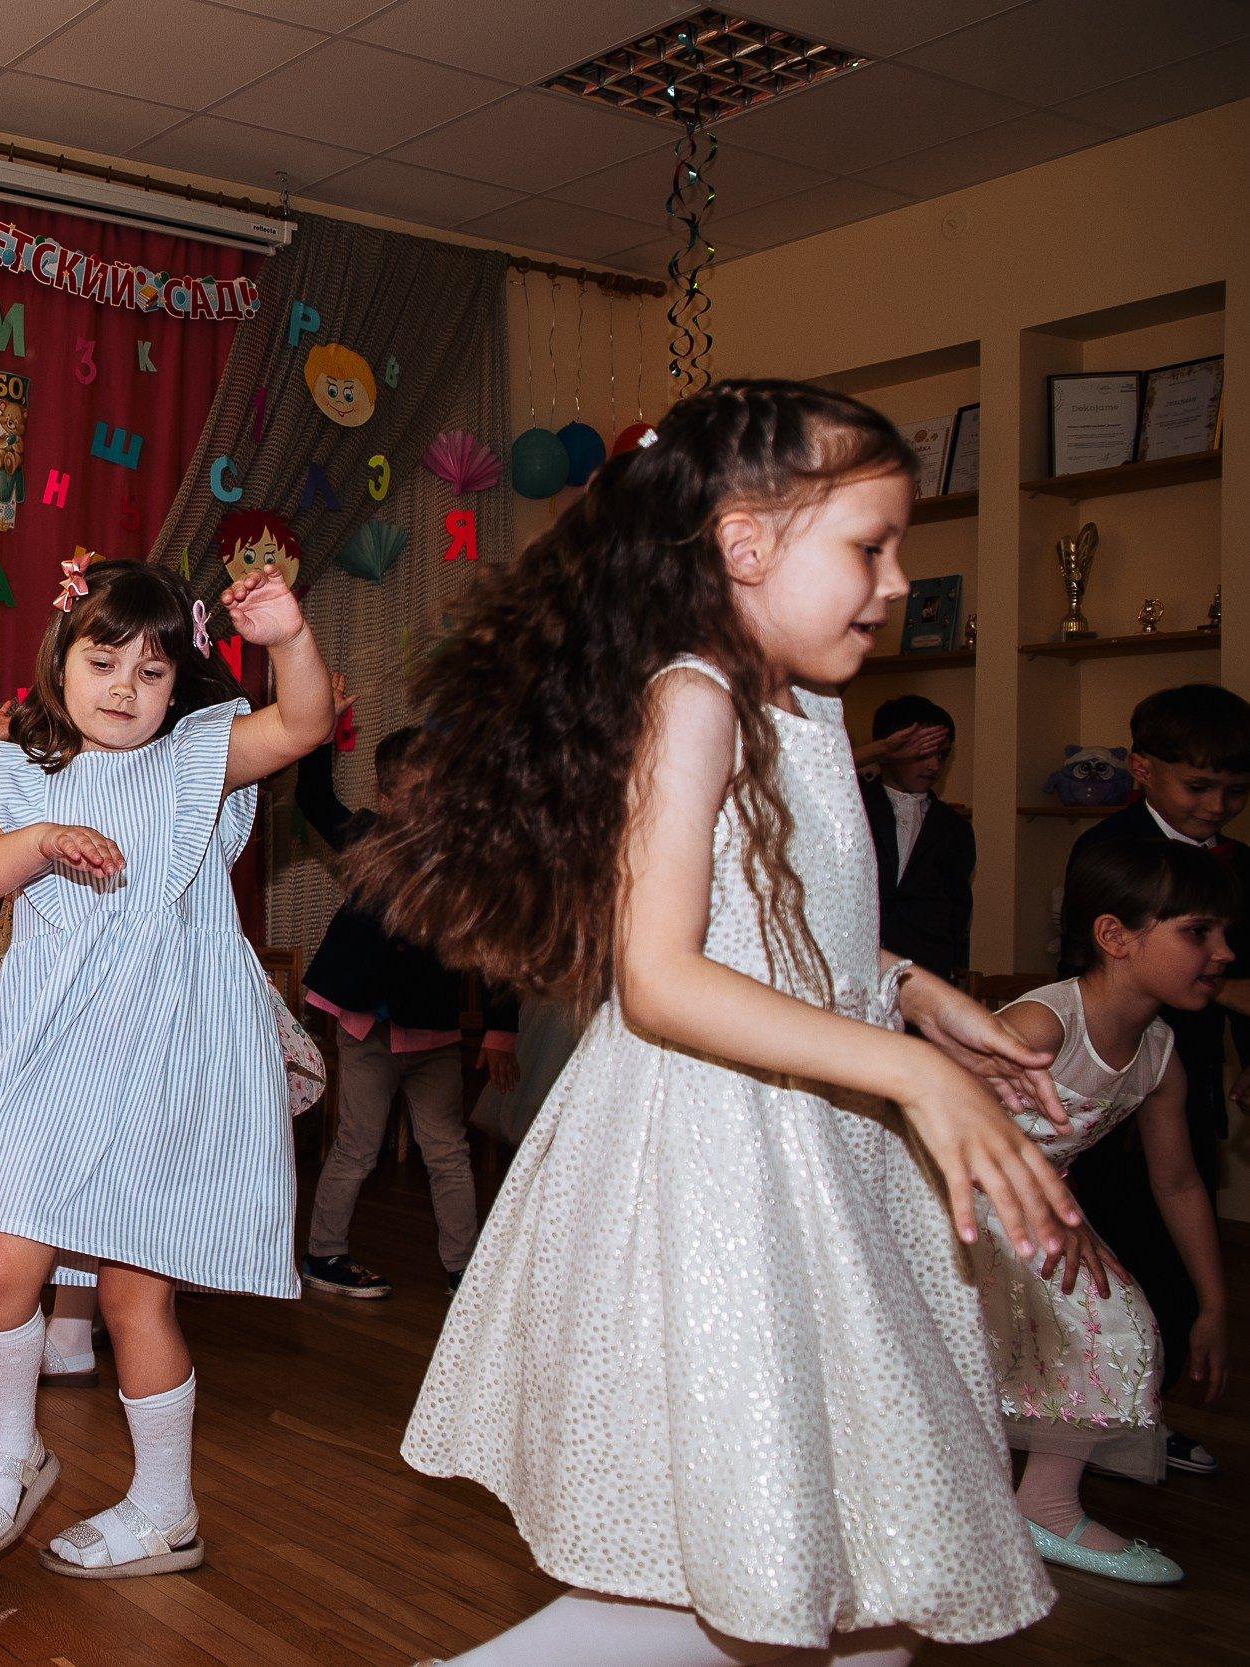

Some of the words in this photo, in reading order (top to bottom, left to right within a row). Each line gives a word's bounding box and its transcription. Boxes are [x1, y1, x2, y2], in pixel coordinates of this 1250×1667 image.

[253, 225, 276, 234] reflecta
[163, 278, 256, 320] САД!
[288, 300, 321, 347] Р
[137, 340, 157, 372] К
[42, 469, 70, 508] Н
[210, 455, 243, 502] С
[444, 510, 478, 561] Я
